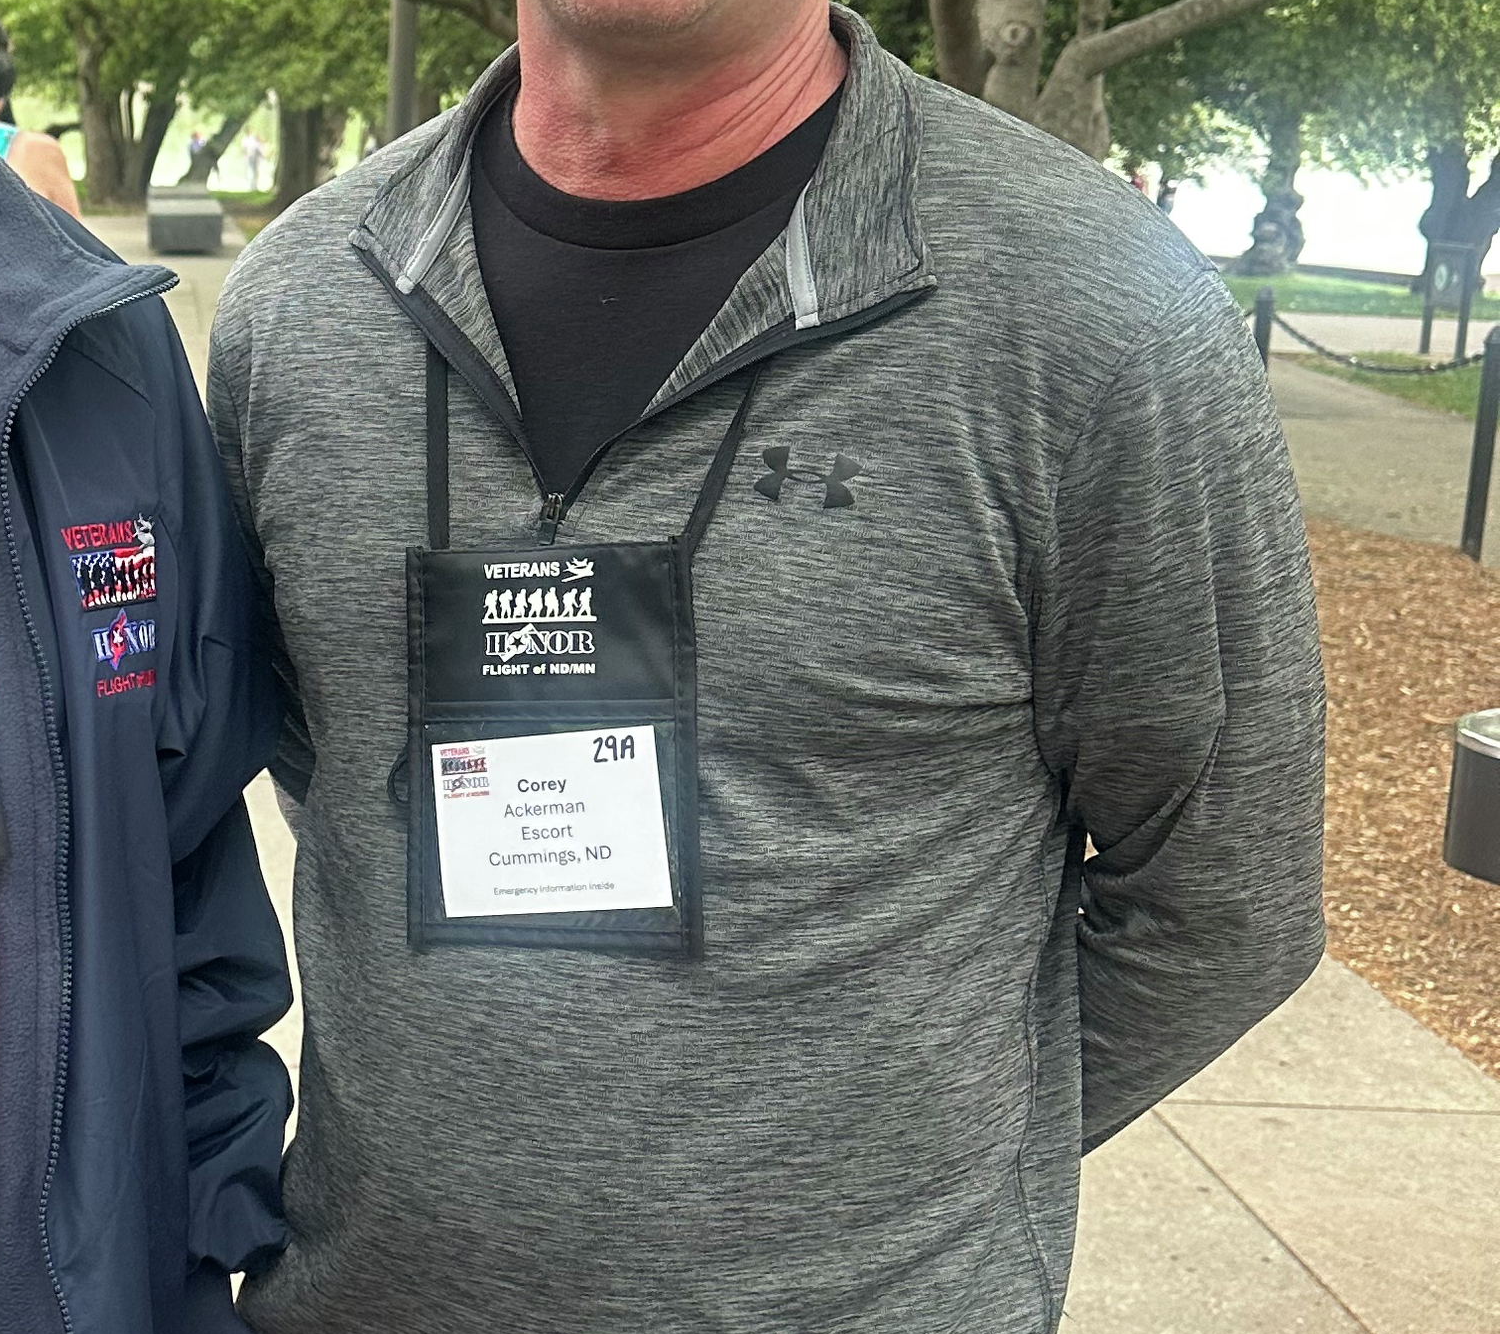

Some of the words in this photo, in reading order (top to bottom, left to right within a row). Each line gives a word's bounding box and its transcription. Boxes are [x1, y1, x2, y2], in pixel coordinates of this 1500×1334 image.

[61, 520, 134, 551] VETERANS
[483, 561, 561, 580] VETERANS
[485, 626, 596, 659] HONOR
[482, 664, 530, 676] FLIGHT
[532, 663, 547, 675] of
[549, 663, 596, 674] ND/MN
[96, 672, 136, 698] FLIGHT
[592, 734, 635, 763] 29A
[517, 778, 567, 794] Corey
[503, 801, 586, 819] Ackerman
[521, 824, 574, 841] Escort
[488, 848, 581, 867] Cummings,
[584, 845, 612, 862] ND
